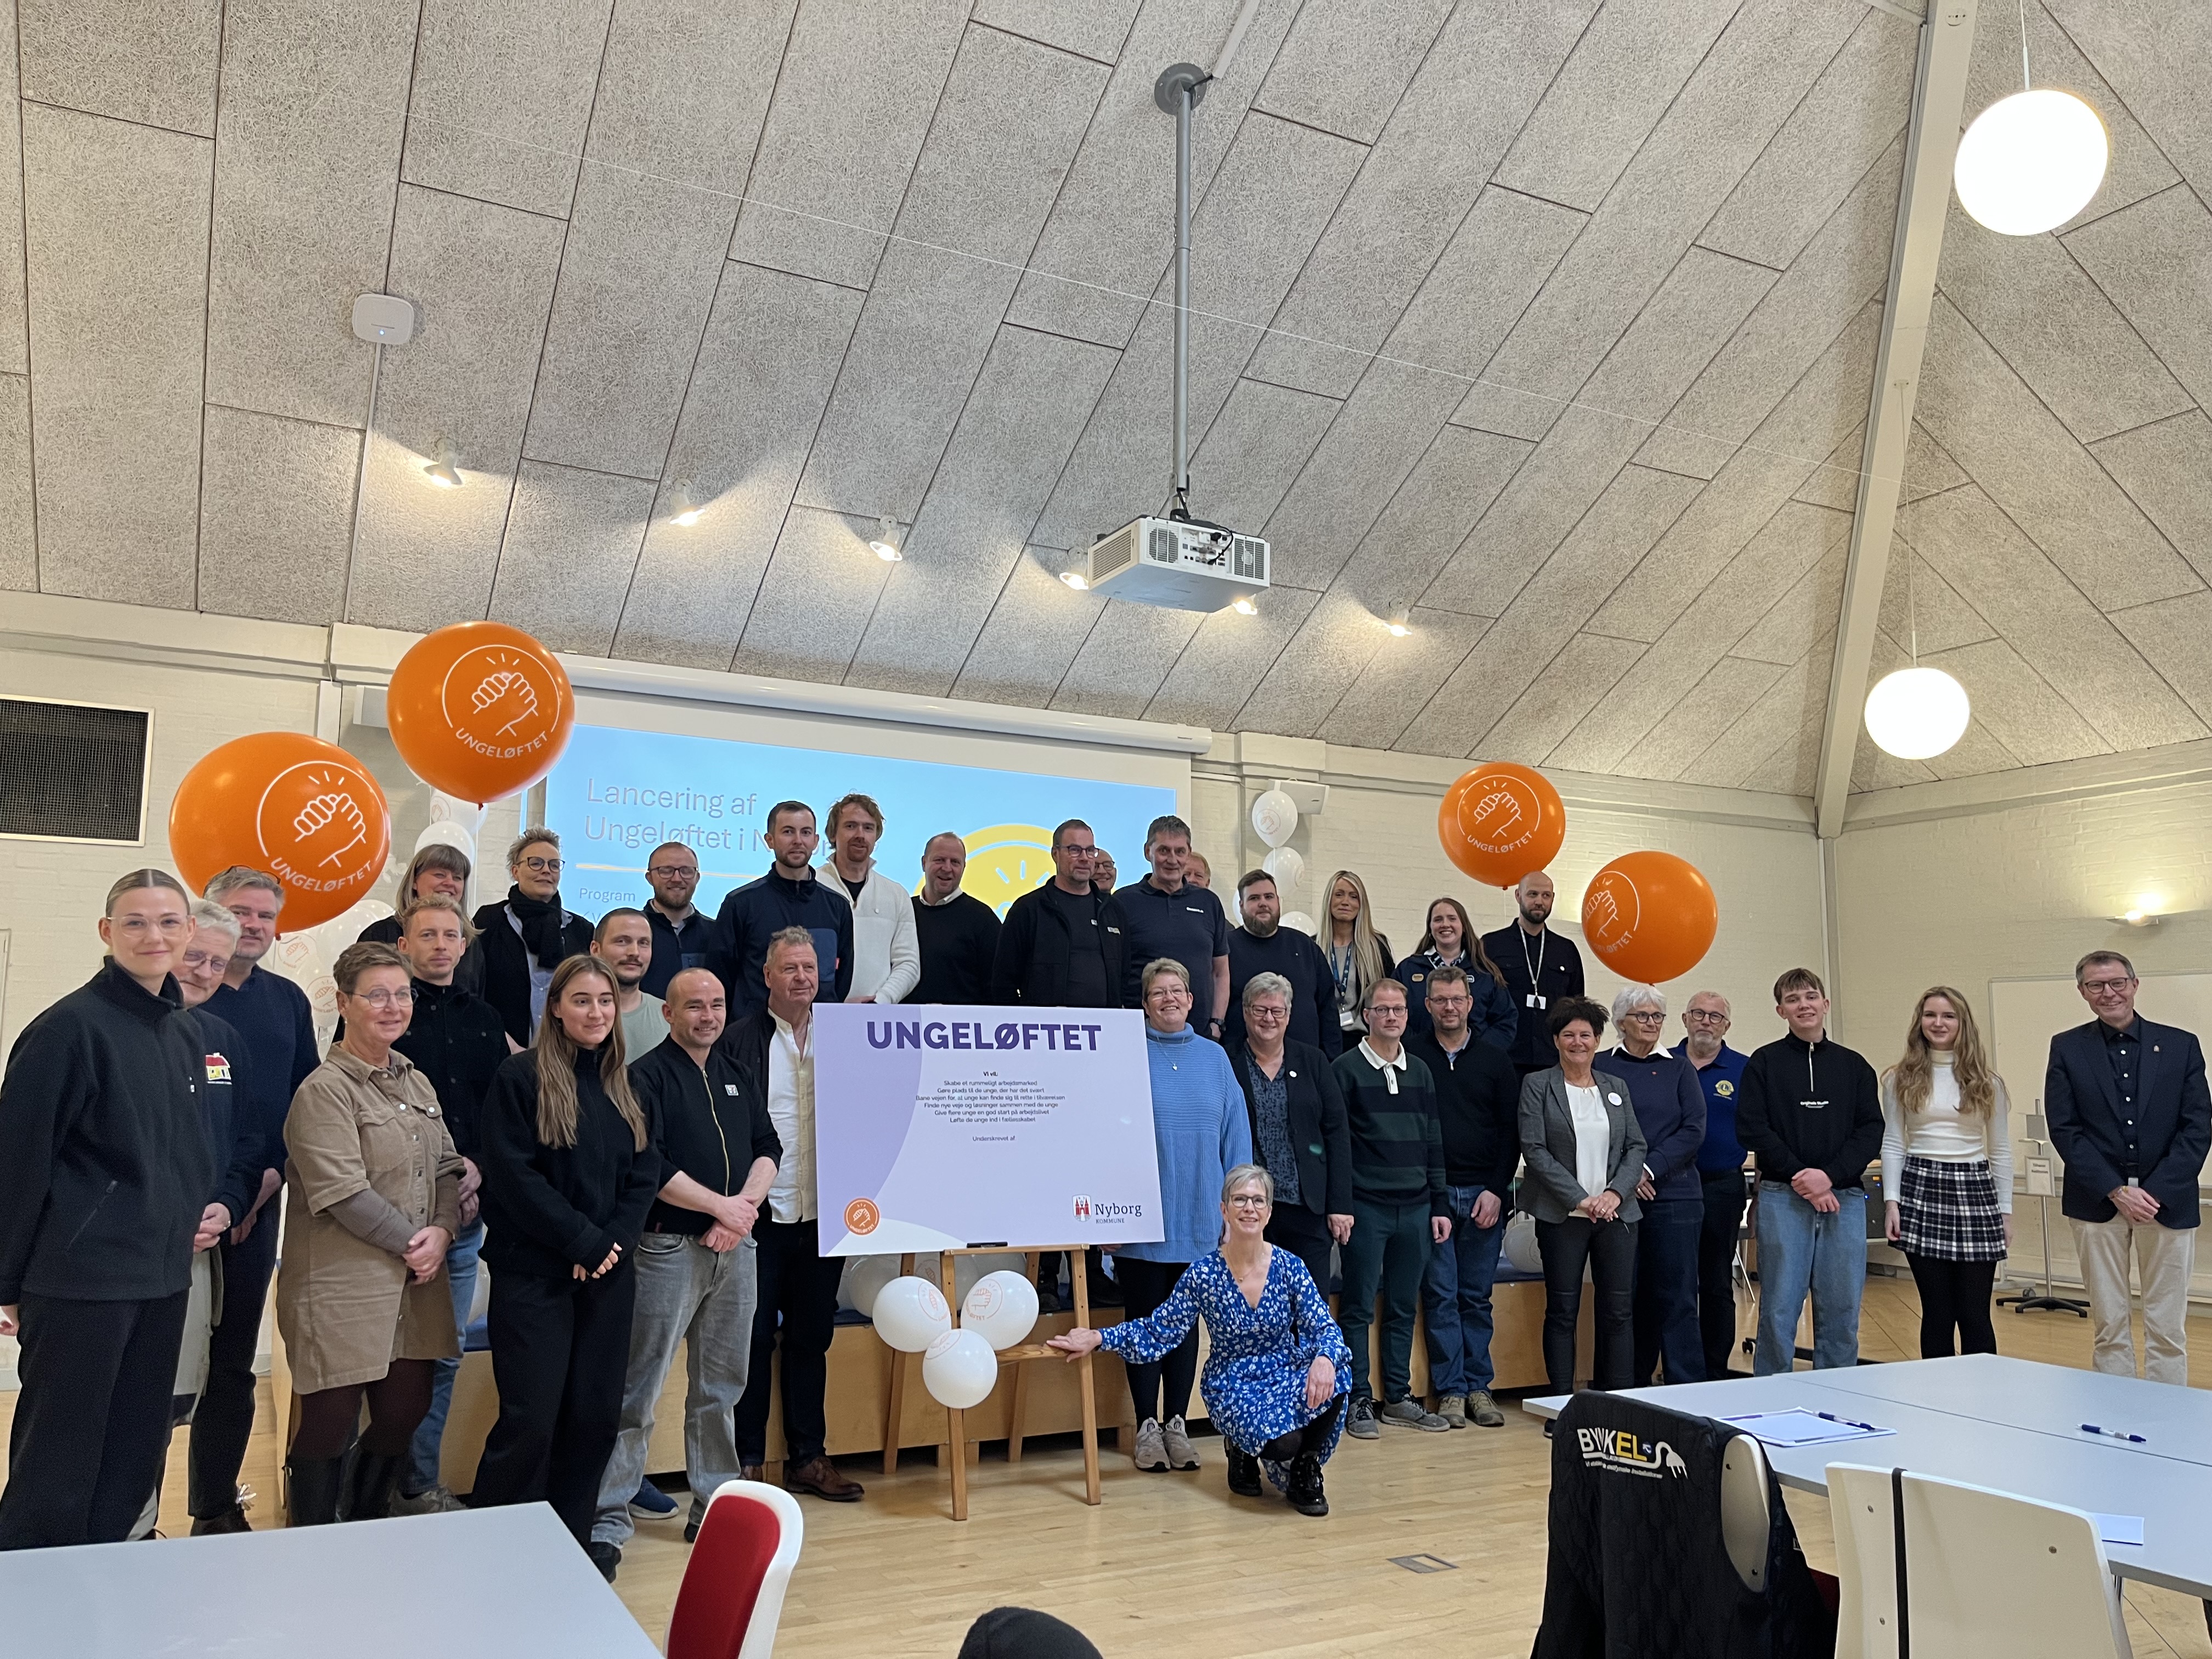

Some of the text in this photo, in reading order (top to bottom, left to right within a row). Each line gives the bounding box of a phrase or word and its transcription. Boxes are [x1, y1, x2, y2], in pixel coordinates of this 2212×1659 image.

[456, 727, 548, 758] UNGELØFTET
[588, 778, 757, 819] Lancering af
[585, 815, 732, 850] Ungeløftet
[738, 828, 744, 850] i
[1467, 831, 1532, 853] UNGELØFTET
[270, 857, 371, 892] UNGELØFTET
[579, 888, 636, 903] Program
[867, 1022, 1102, 1051] UNGELØFTET
[1094, 1203, 1142, 1217] Nyborg
